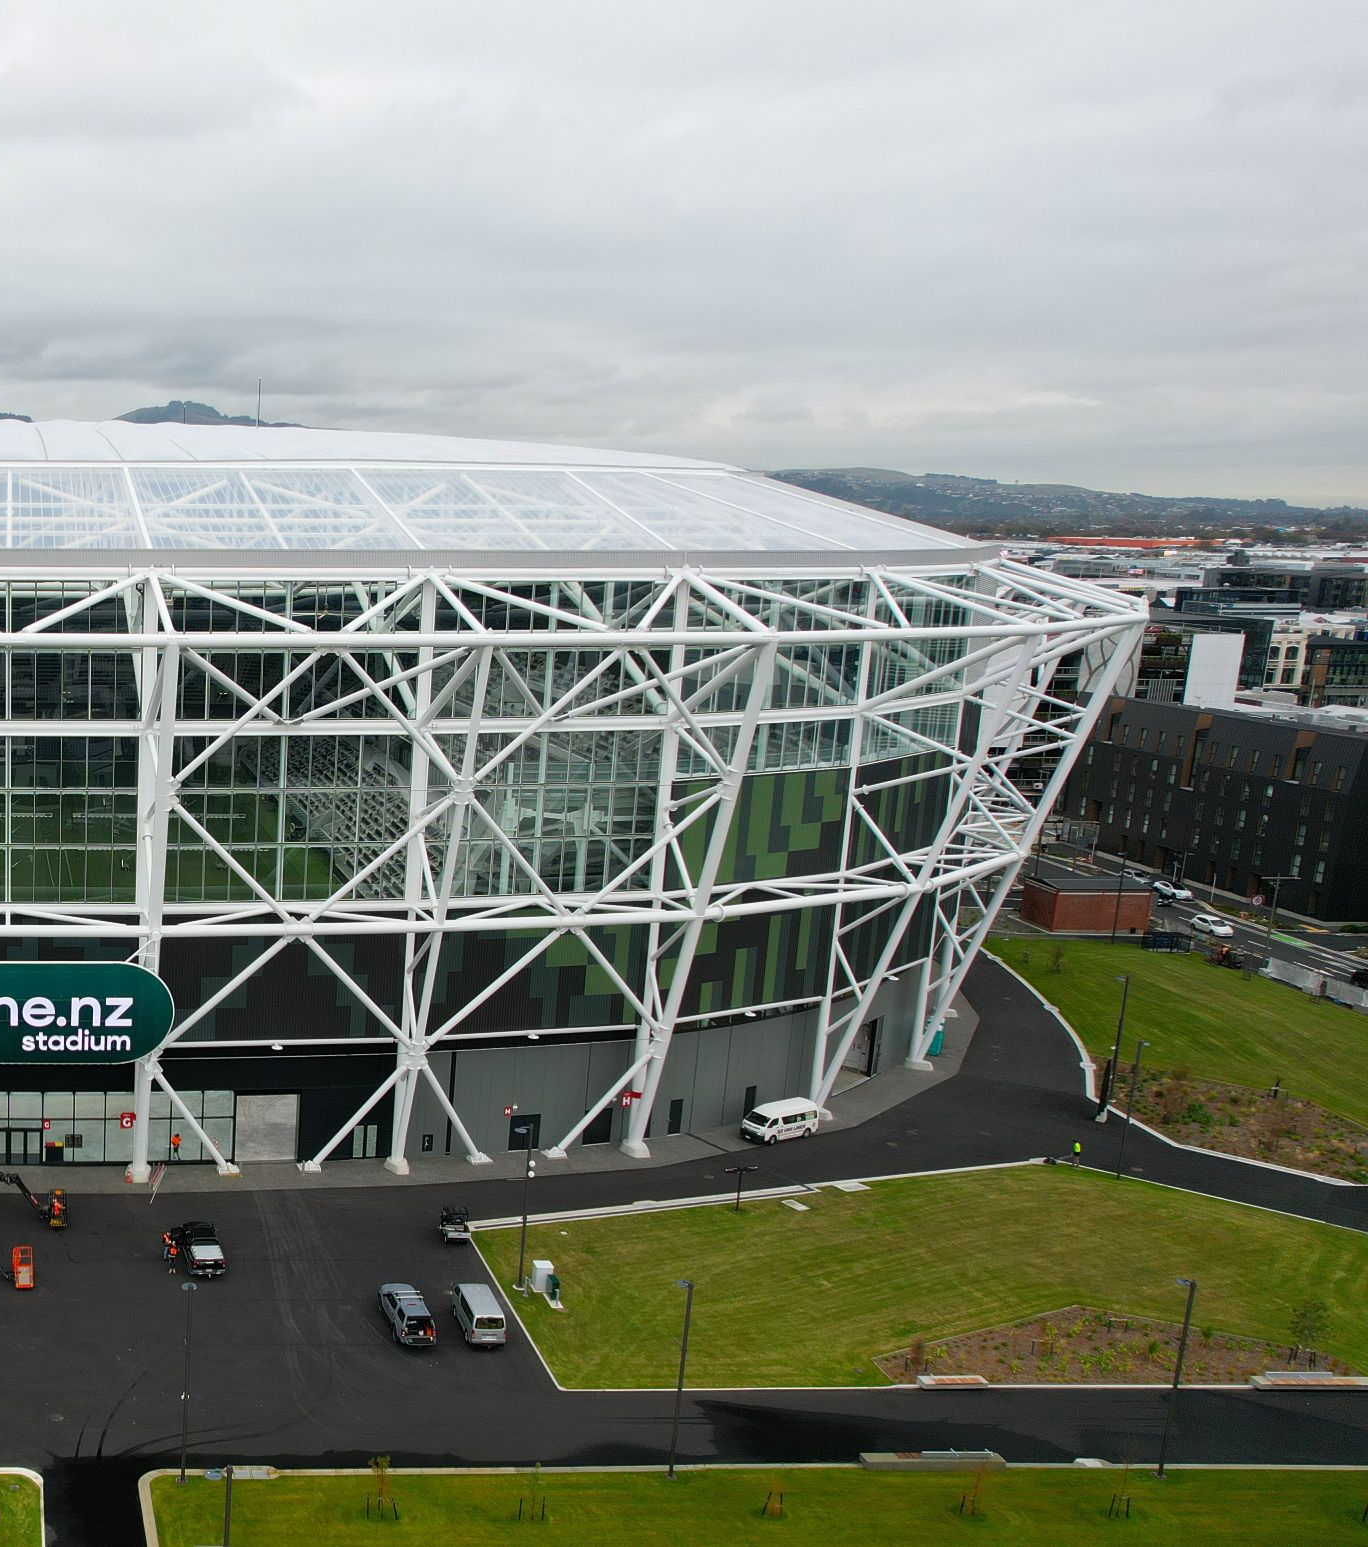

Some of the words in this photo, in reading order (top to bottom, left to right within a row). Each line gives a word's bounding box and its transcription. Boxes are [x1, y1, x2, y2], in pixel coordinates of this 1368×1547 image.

[21, 1029, 131, 1051] stadium
[623, 1097, 631, 1106] H
[122, 1117, 132, 1127] G
